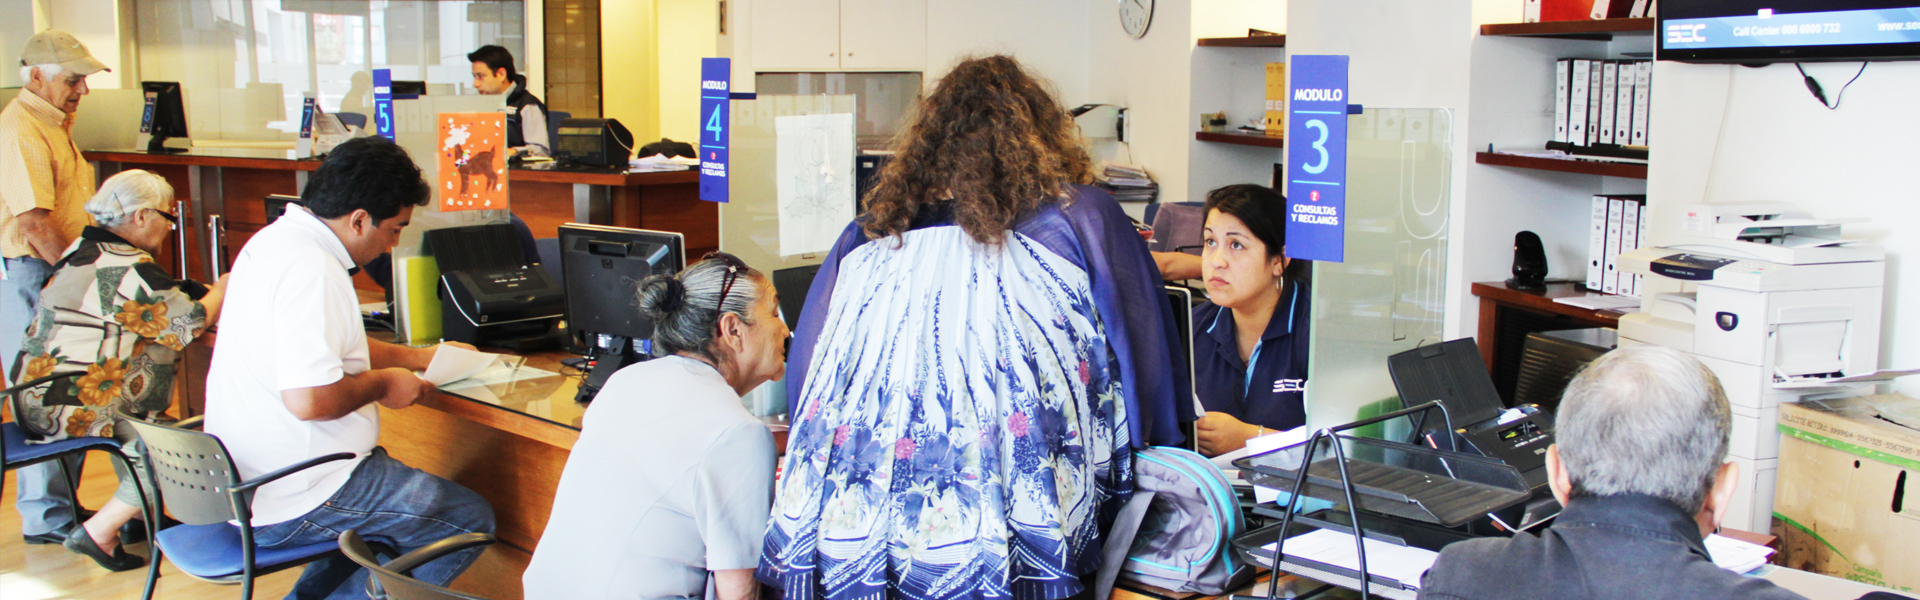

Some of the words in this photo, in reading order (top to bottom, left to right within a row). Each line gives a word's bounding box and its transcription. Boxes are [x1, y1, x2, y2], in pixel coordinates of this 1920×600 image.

[1667, 23, 1706, 43] SEC
[1733, 26, 1750, 36] Call
[1751, 26, 1780, 36] Center
[1782, 24, 1798, 35] 600
[1799, 23, 1821, 34] 6000
[1823, 22, 1841, 33] 732
[1877, 21, 1920, 31] www.se
[701, 80, 727, 91] MODULO
[1294, 88, 1343, 102] MODULO
[144, 107, 152, 122] 8
[304, 109, 312, 126] 7
[379, 103, 390, 133] 5
[705, 103, 723, 141] 4
[1302, 119, 1329, 174] 3
[1293, 203, 1337, 216] CONSULTAS
[1291, 213, 1297, 222] Y
[1298, 214, 1338, 226] RECLAMOS
[1272, 378, 1305, 393] SEC
